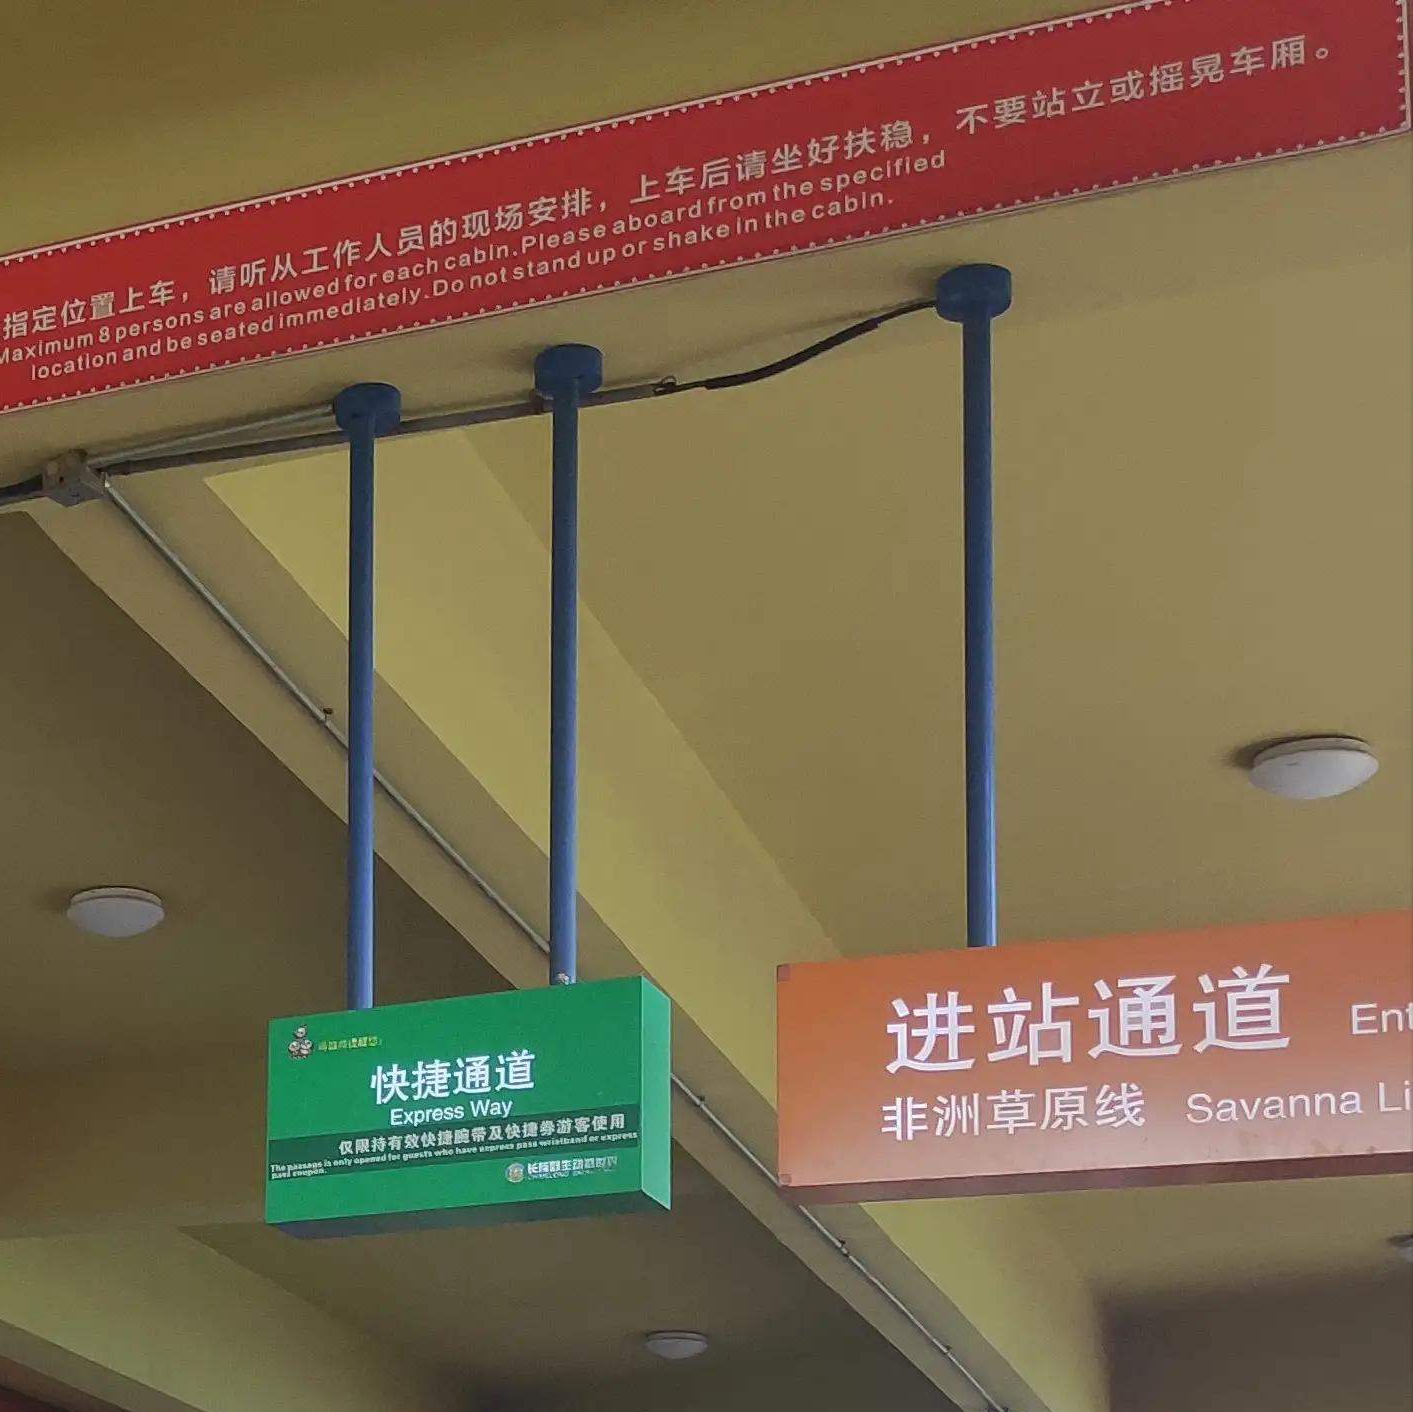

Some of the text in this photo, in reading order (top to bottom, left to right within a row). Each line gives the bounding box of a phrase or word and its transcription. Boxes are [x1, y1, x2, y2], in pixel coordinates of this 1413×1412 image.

[31, 352, 119, 380] location
[122, 339, 162, 361] and
[167, 333, 192, 352] be
[197, 315, 275, 346] seated
[470, 267, 508, 290] not
[512, 252, 581, 280] stand
[587, 246, 616, 266] up
[622, 237, 648, 259] or
[653, 221, 730, 252] shake
[736, 213, 759, 234] in
[764, 208, 806, 230] the
[811, 190, 894, 220] cabin.
[98, 327, 110, 343] 8
[115, 310, 204, 344] persons
[210, 300, 246, 319] are
[252, 276, 340, 311] allowed
[344, 268, 378, 293] for
[382, 255, 440, 284] each
[612, 198, 703, 236] aboard
[708, 190, 768, 215] from
[772, 181, 814, 203] the
[820, 149, 946, 192] specified
[885, 962, 1292, 1074] 进站通道
[370, 1049, 536, 1105] 快捷通道
[390, 1099, 513, 1127] Express Way
[881, 1081, 1147, 1141] 非洲草原线
[1186, 1086, 1363, 1125] Savanna
